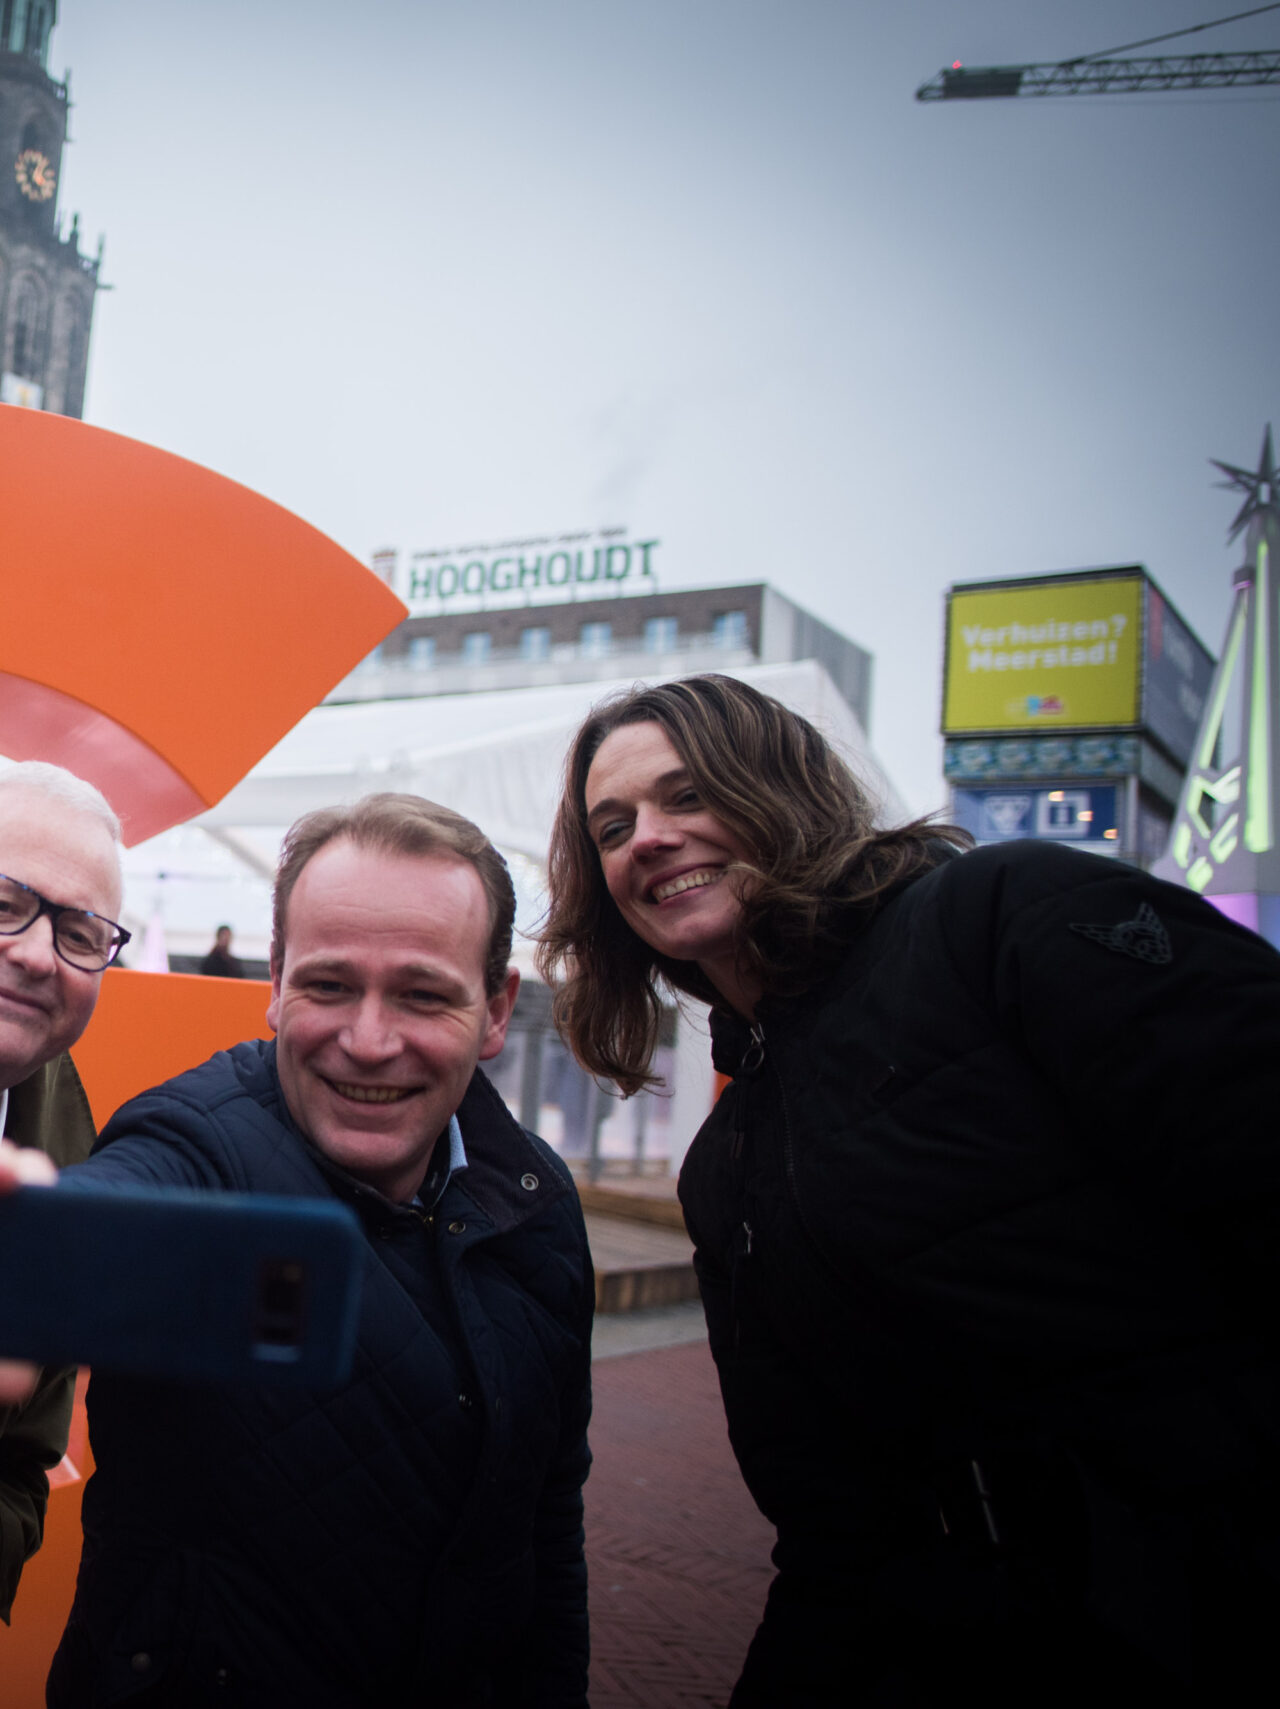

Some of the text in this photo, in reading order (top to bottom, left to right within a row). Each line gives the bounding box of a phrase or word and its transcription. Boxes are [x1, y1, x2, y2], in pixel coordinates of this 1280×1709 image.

[408, 537, 660, 600] HOOGHOUDT
[961, 613, 1128, 648] Verhuizen?
[967, 639, 1119, 674] Meerstad!
